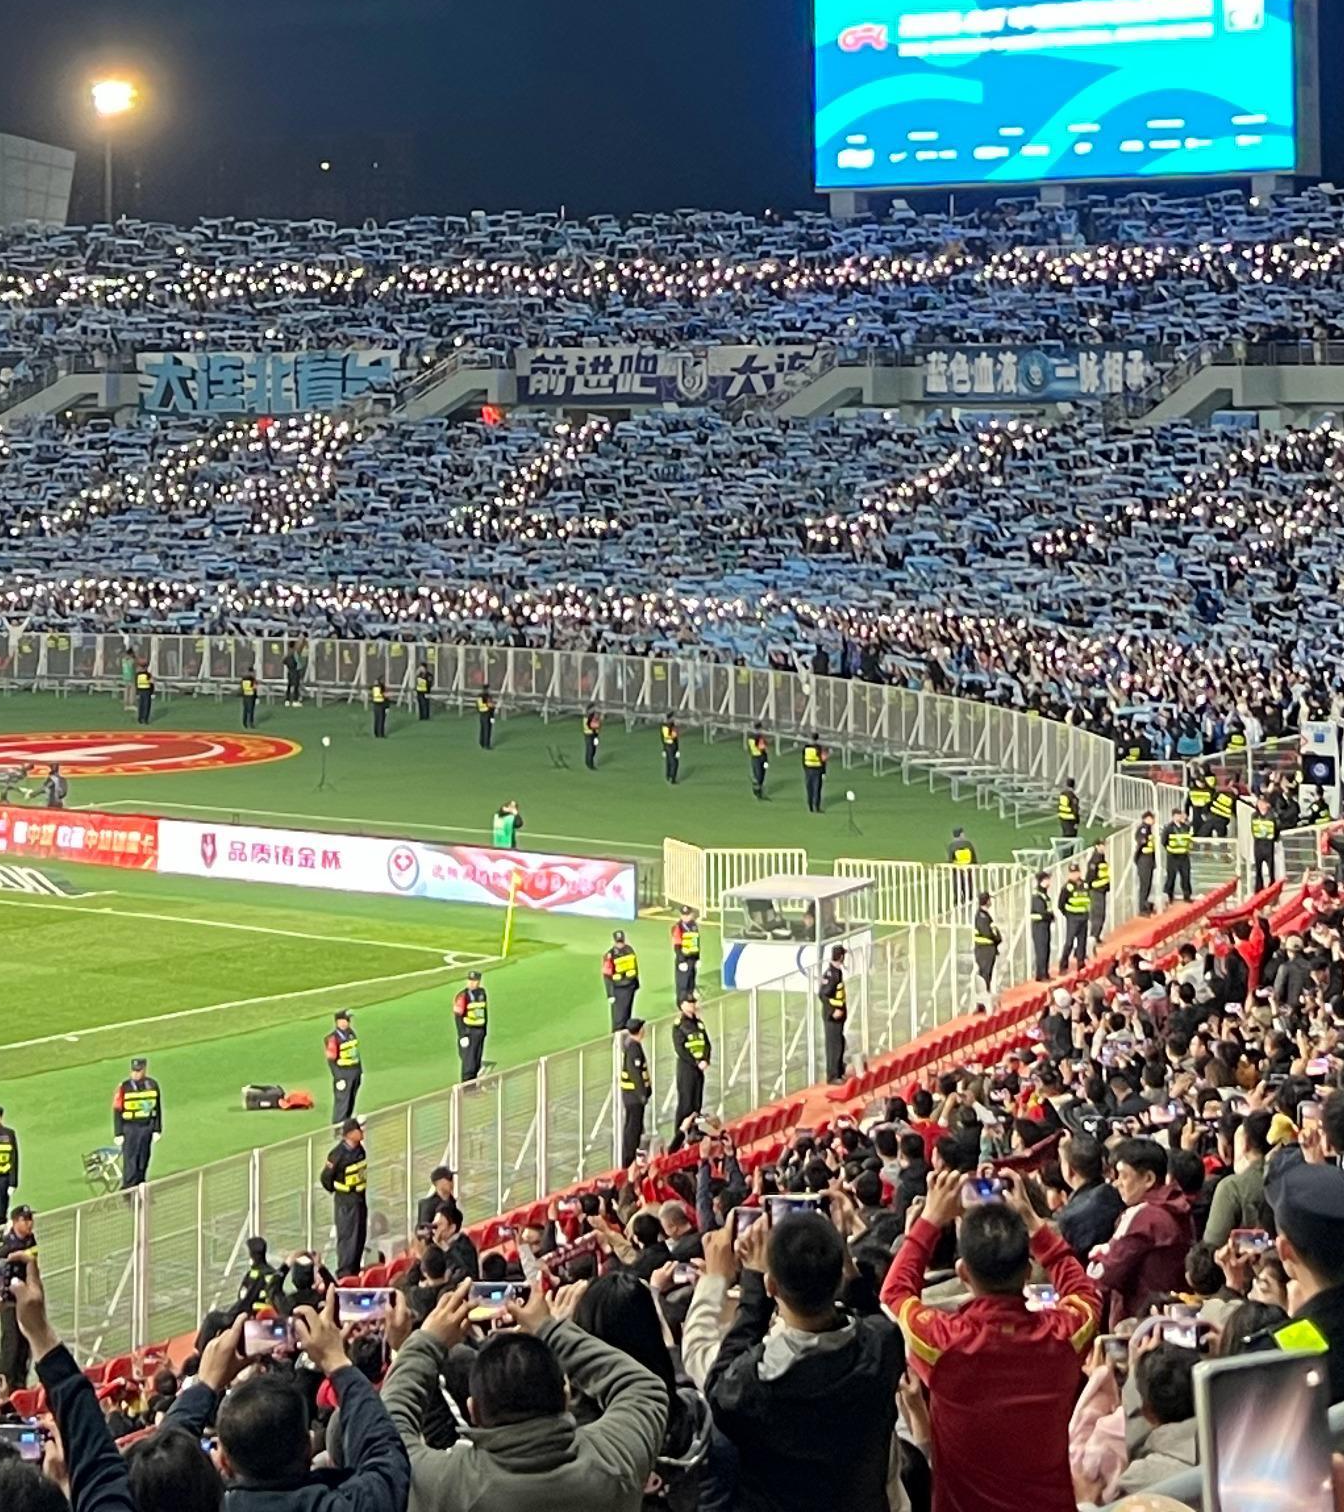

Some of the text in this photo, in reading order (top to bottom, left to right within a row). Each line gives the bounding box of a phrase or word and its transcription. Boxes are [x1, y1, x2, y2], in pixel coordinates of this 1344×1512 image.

[529, 352, 659, 396] 前进吧
[925, 350, 1018, 393] 蓝色血液
[228, 840, 342, 870] 品质铸金杯
